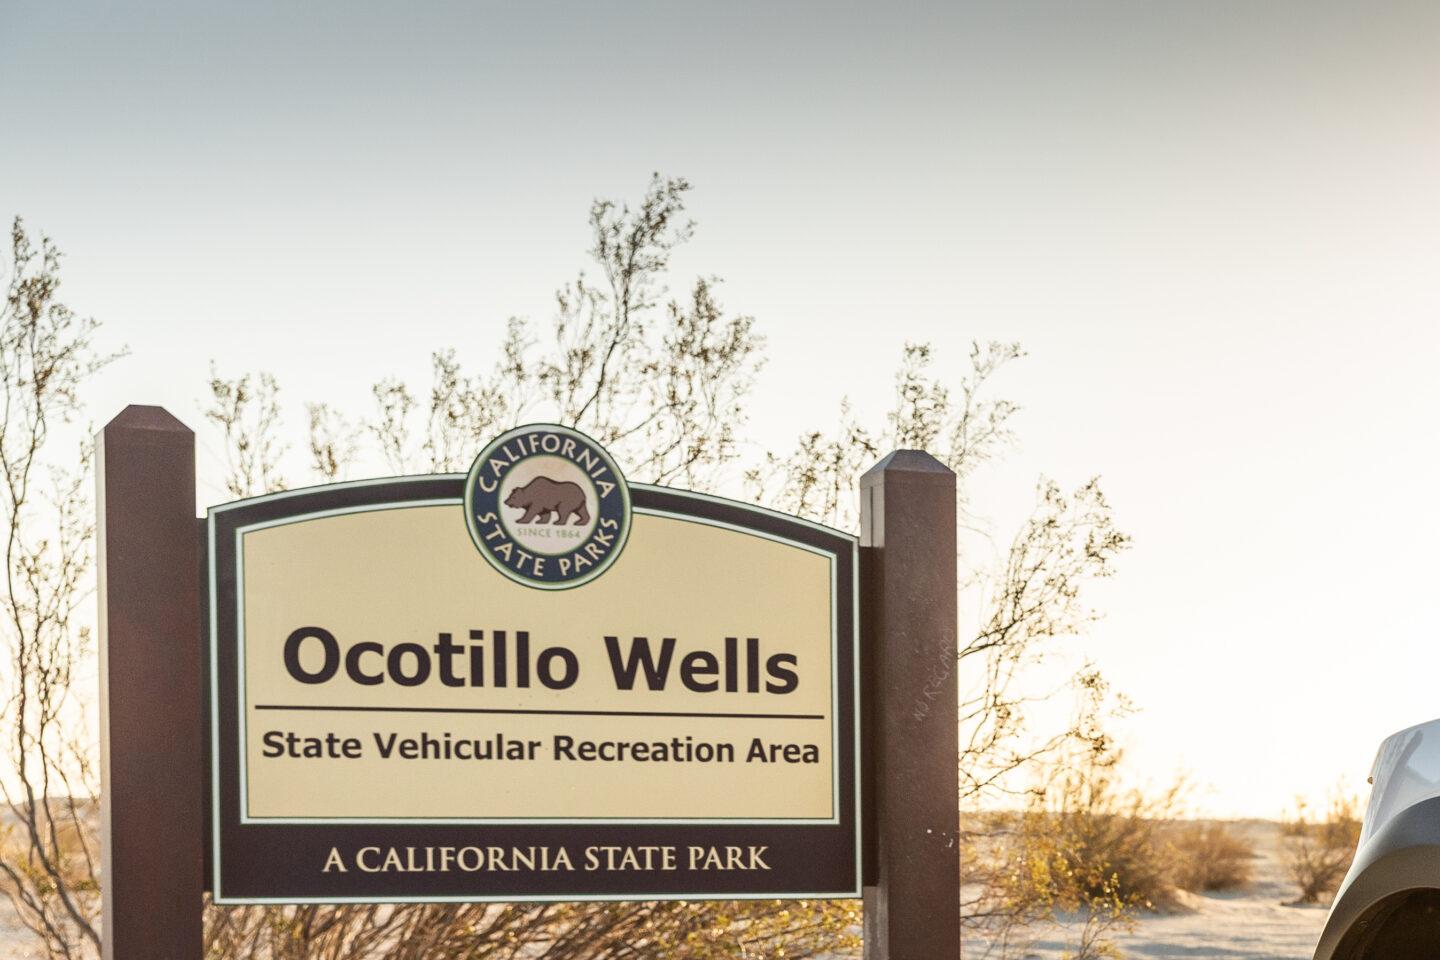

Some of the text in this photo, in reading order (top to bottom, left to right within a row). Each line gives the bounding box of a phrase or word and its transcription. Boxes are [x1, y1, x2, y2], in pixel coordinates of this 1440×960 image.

[479, 434, 616, 498] CALIFORNIA
[477, 511, 618, 576] STATE PARKS
[517, 528, 581, 538] SINCE 1864
[283, 626, 799, 695] Ocotillo Wells
[262, 730, 820, 764] State Vehicular Recreation Area
[322, 846, 771, 873] A CALIFORNIA STATE PARK
